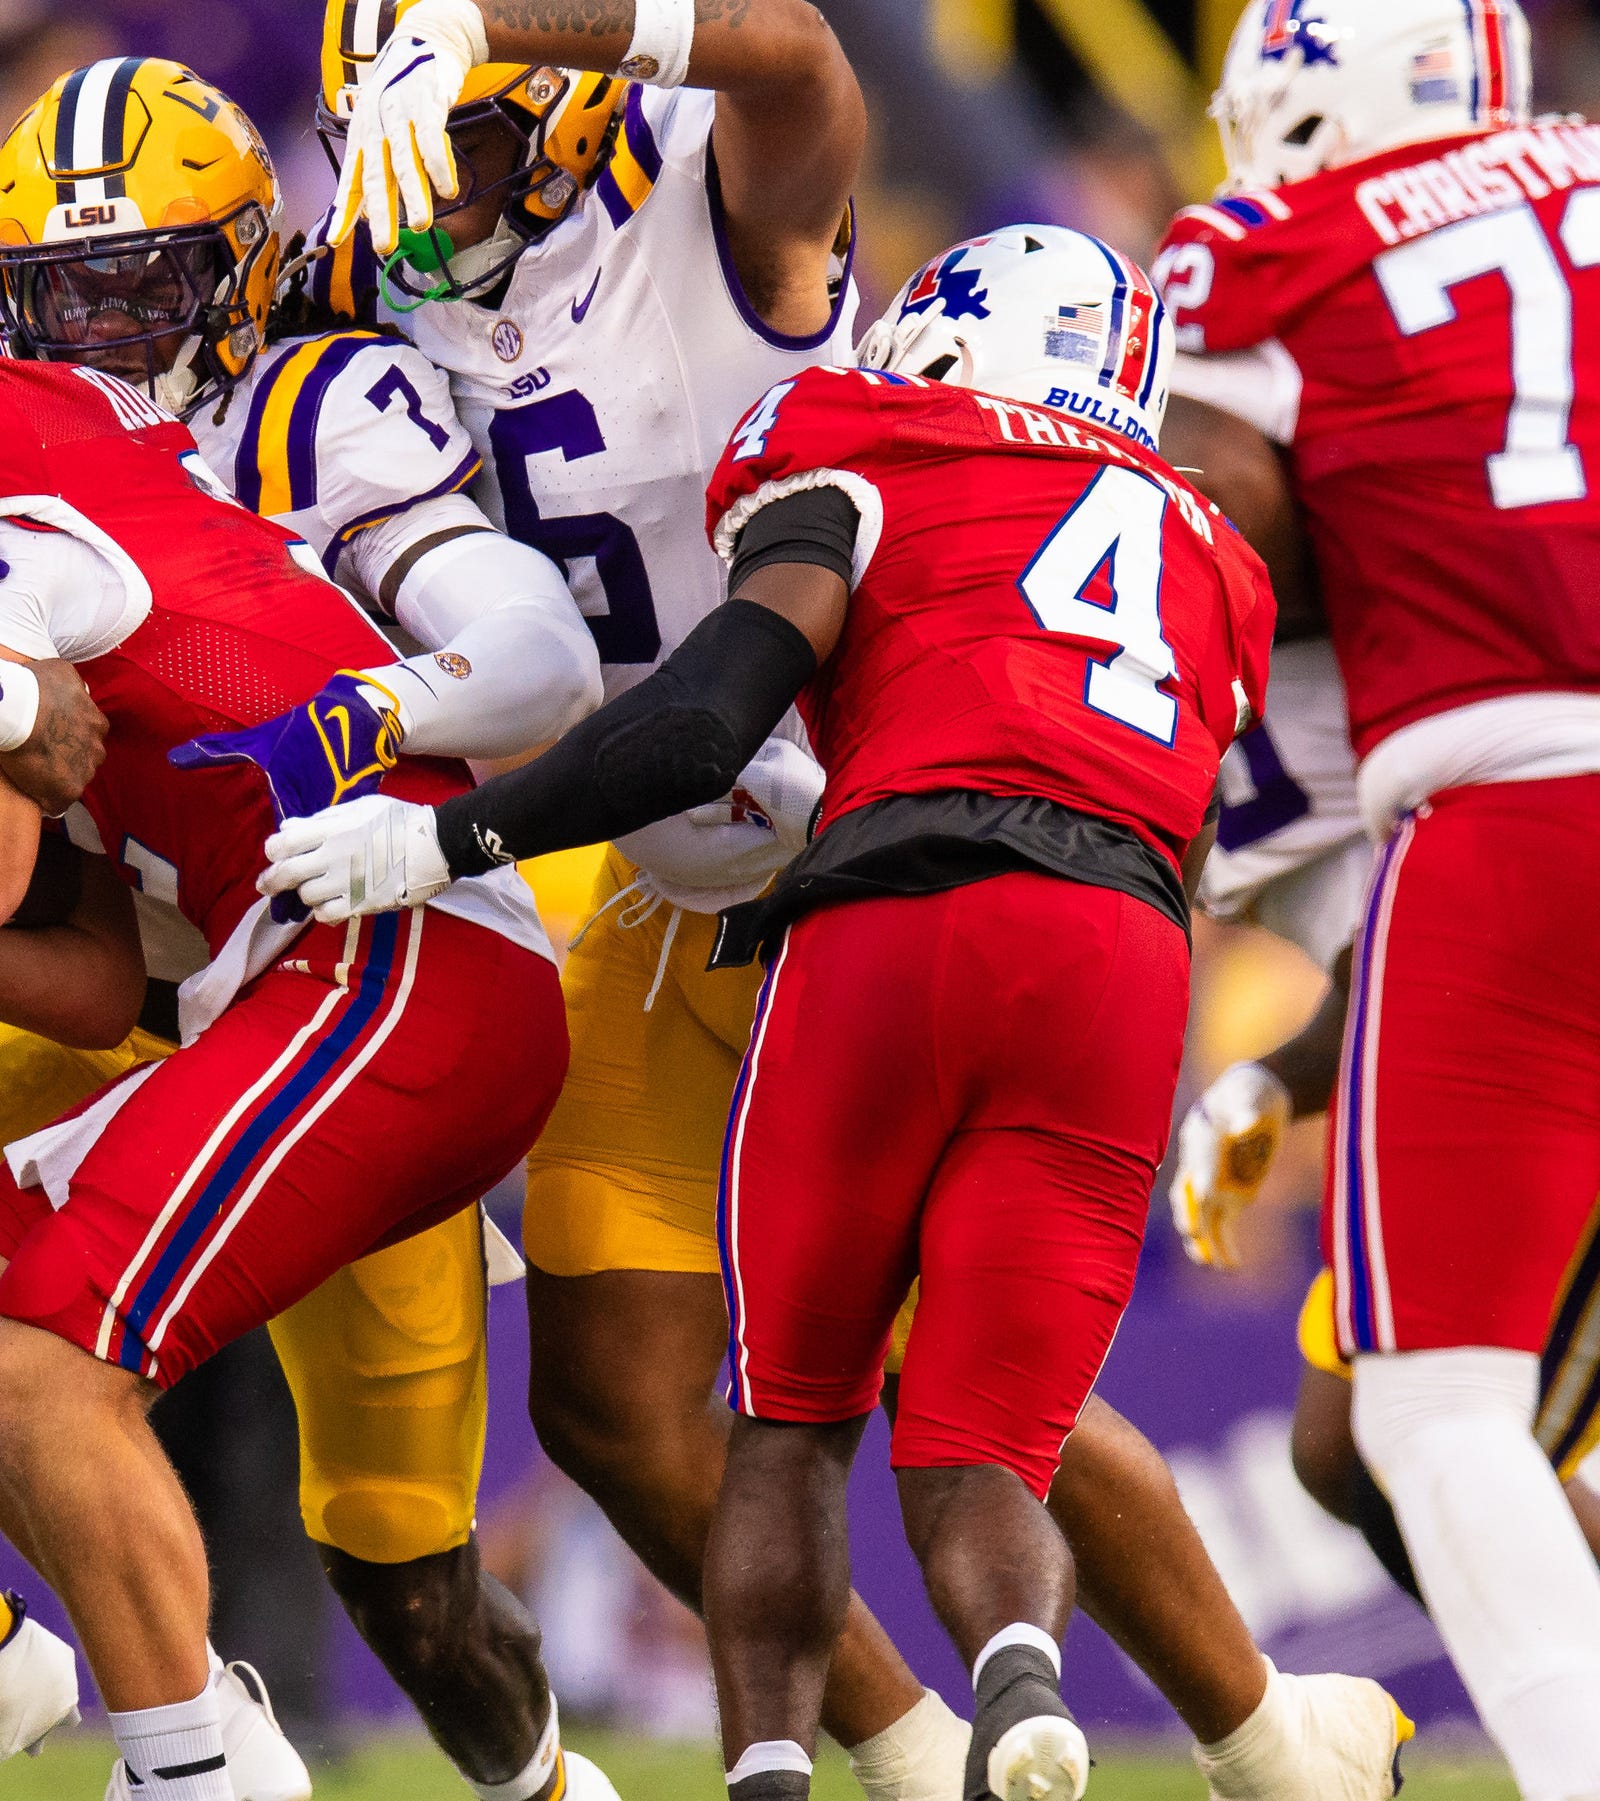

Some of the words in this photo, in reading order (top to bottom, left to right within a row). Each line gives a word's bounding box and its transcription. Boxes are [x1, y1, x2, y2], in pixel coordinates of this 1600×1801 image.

[64, 205, 116, 228] LSU
[500, 366, 551, 399] LSU
[1373, 186, 1600, 511] 7
[365, 364, 451, 452] 7
[732, 381, 798, 463] 4
[489, 389, 662, 664] 6
[1016, 464, 1181, 750] 4
